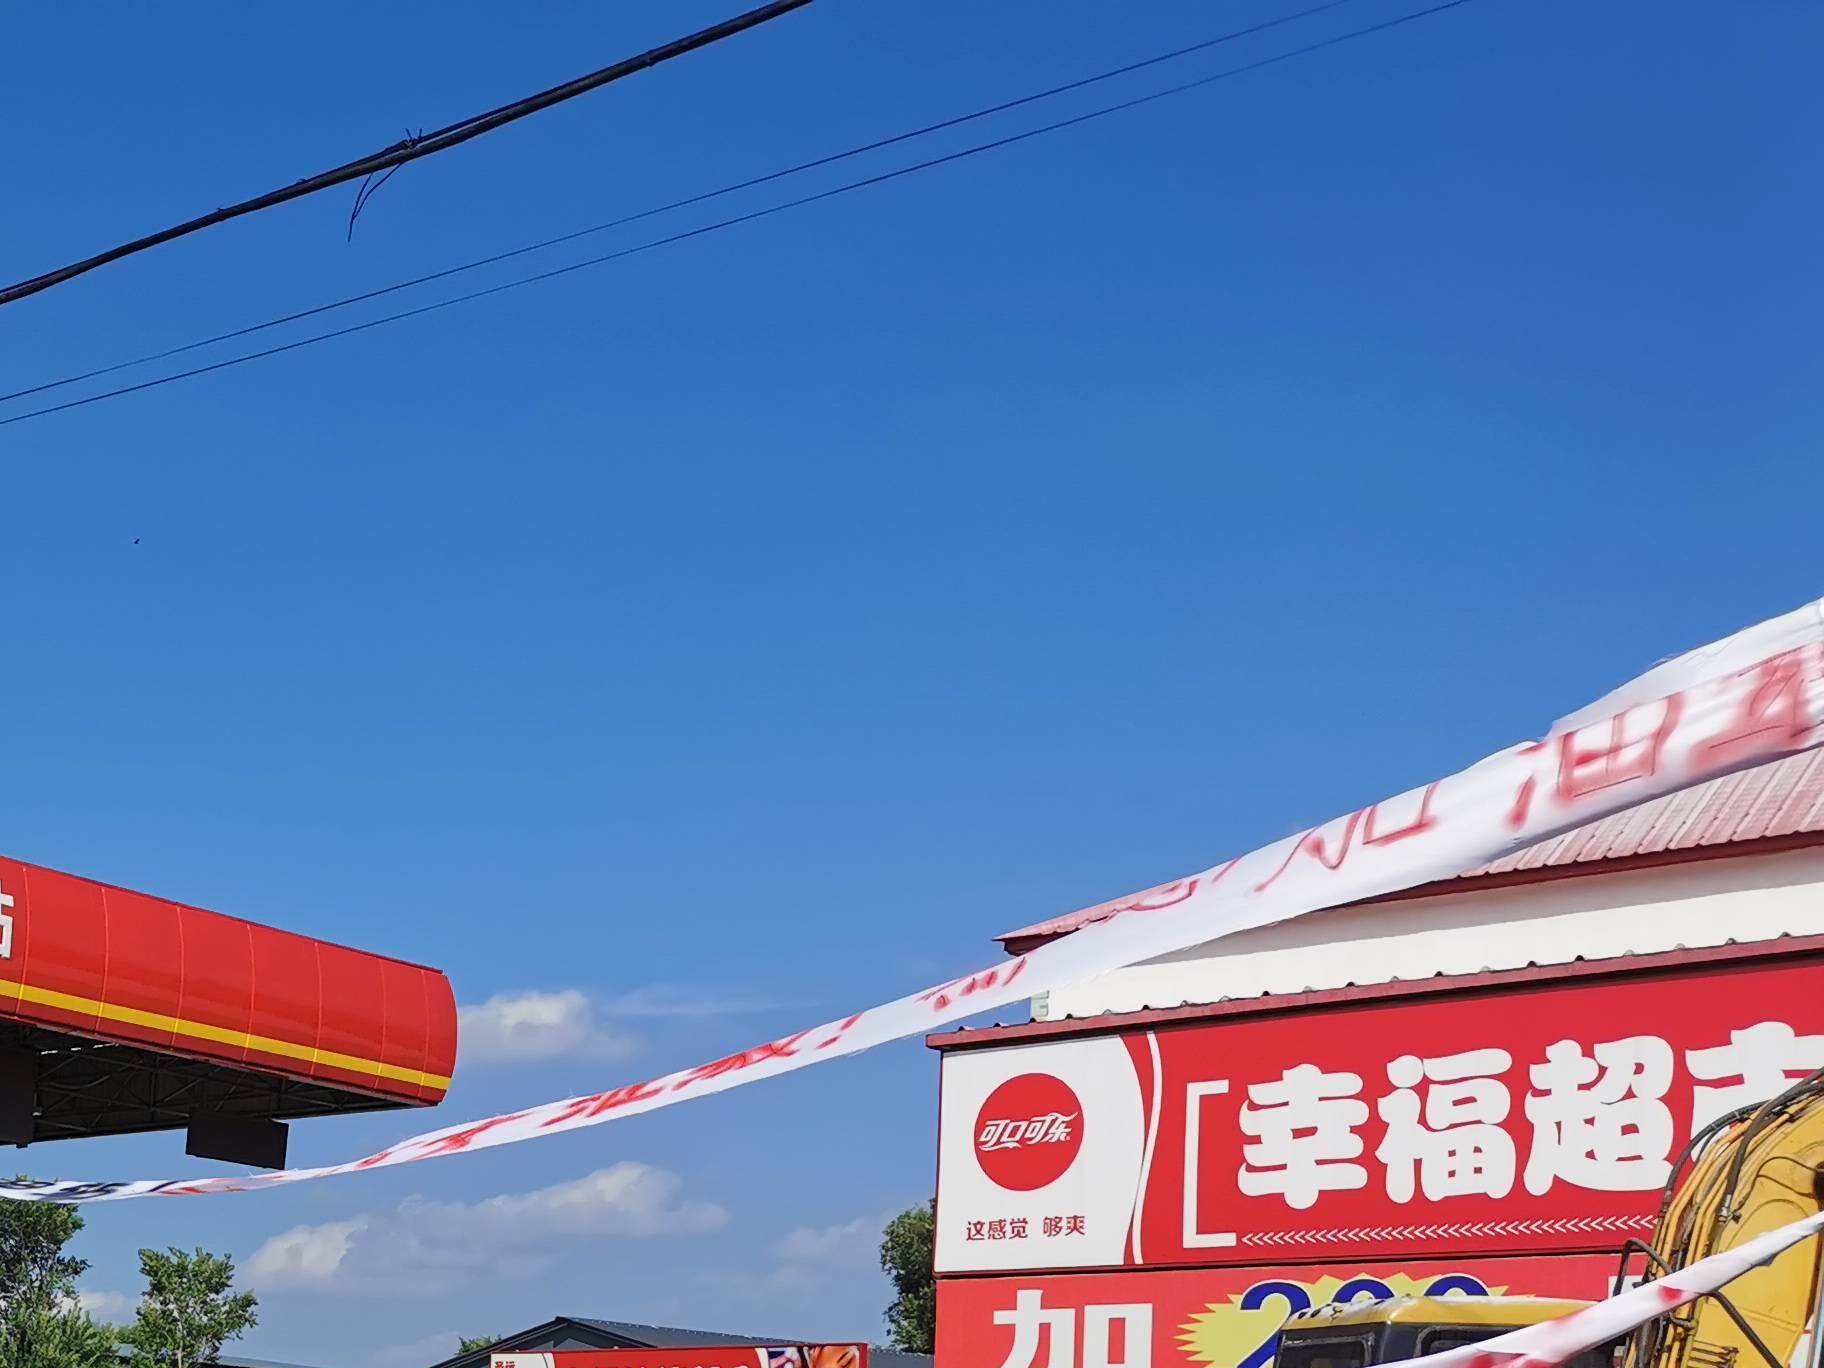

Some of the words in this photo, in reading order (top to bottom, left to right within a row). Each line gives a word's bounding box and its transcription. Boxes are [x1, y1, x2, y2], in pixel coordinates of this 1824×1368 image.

[979, 1112, 1079, 1152] 可口可乐
[966, 1218, 1029, 1242] 这感觉
[1042, 1215, 1086, 1238] 够爽
